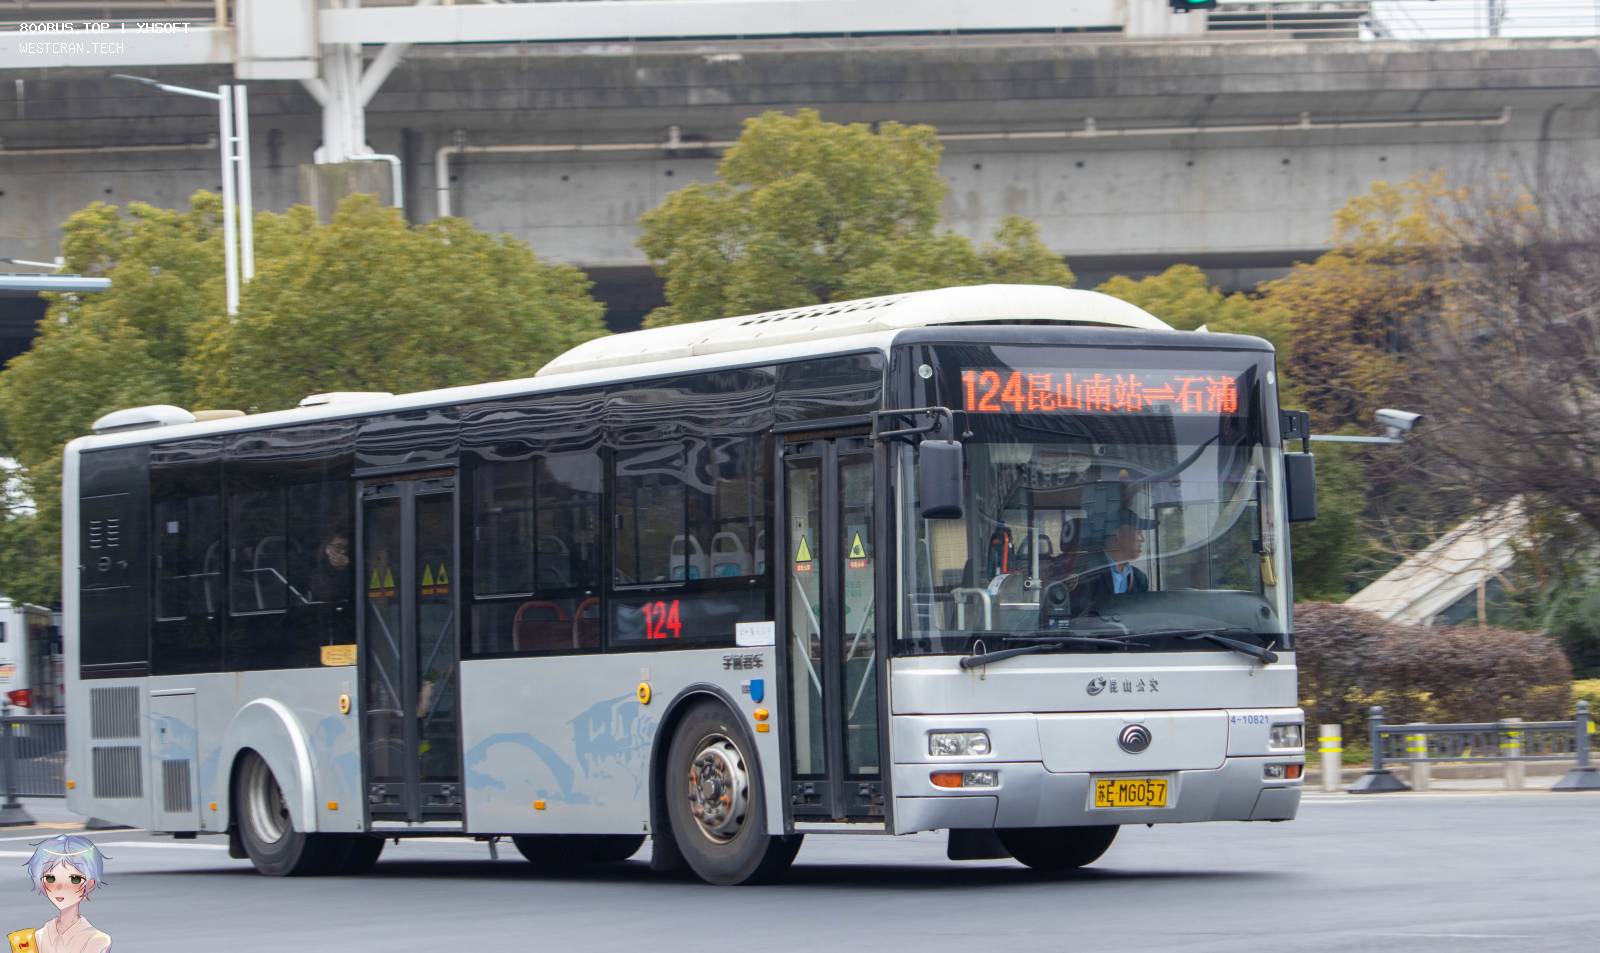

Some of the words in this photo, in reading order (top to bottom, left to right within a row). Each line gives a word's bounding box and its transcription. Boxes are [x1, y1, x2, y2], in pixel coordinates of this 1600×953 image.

[1173, 373, 1238, 414] 石浦
[641, 599, 682, 639] 124
[1109, 678, 1159, 694] 昆山公交
[1230, 714, 1269, 725] 4-10821
